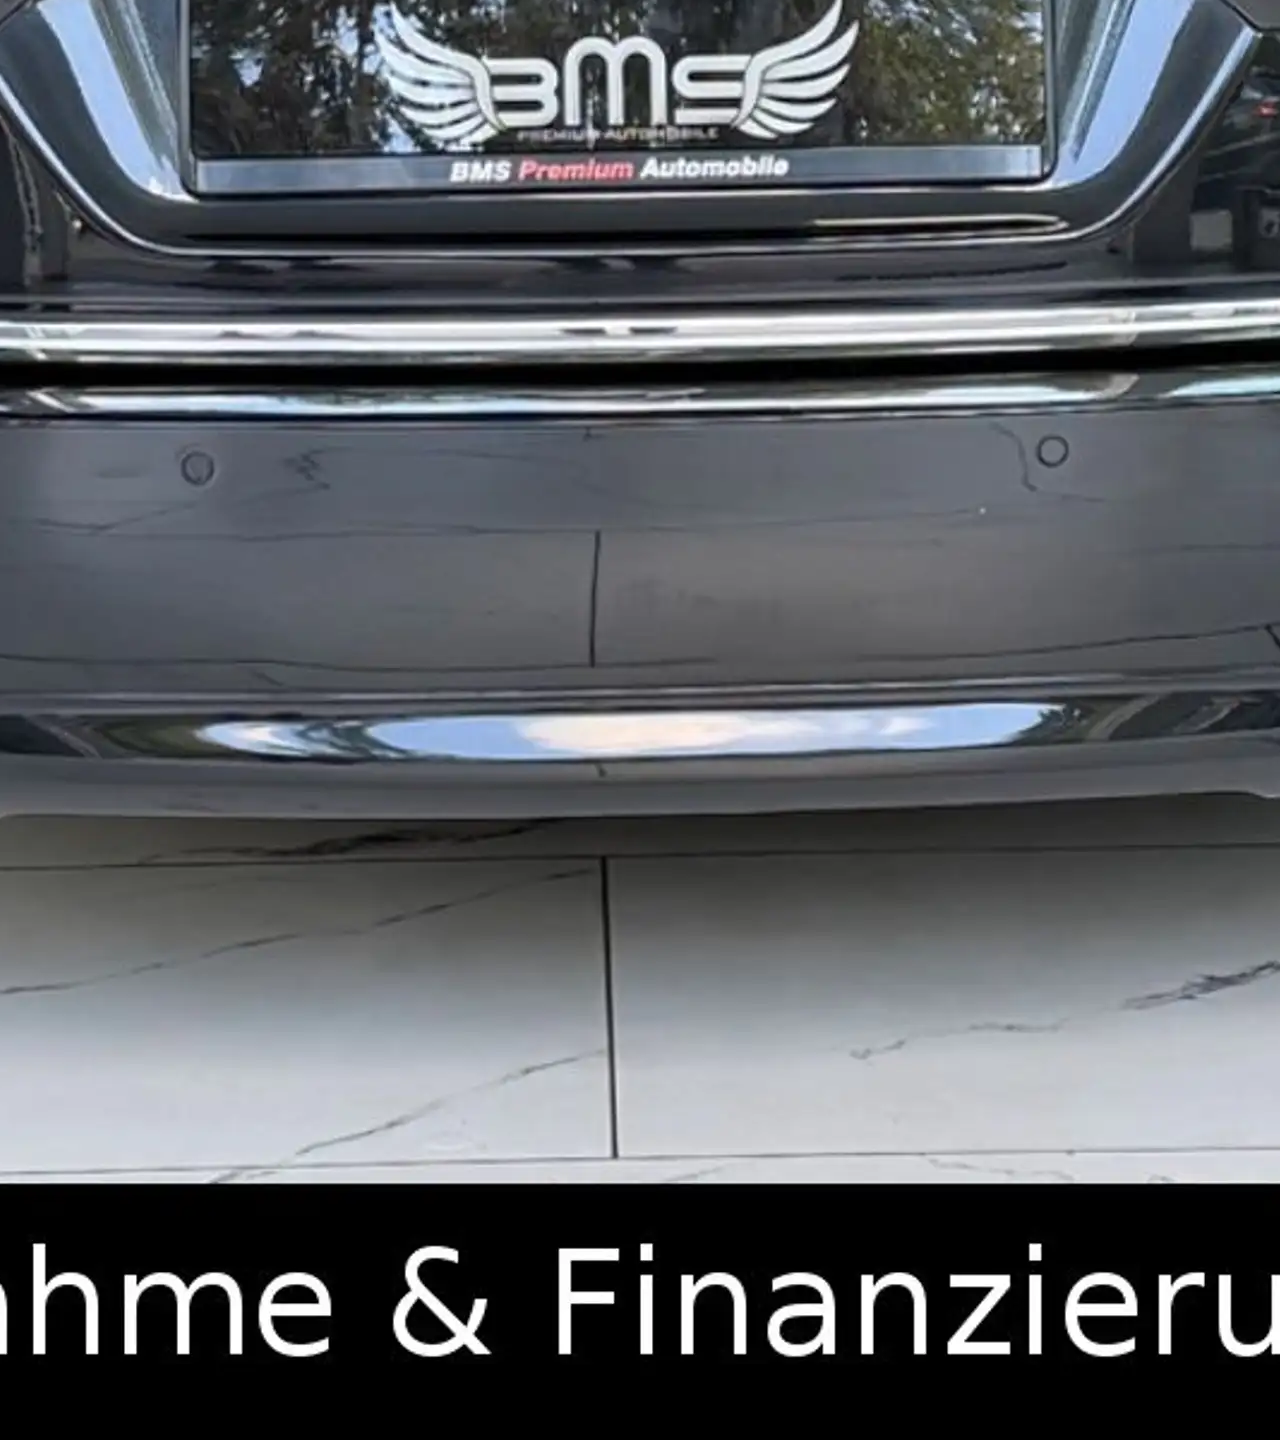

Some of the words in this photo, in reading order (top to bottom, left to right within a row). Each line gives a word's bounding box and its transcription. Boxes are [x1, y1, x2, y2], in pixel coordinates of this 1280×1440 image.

[485, 37, 756, 126] BMS
[449, 162, 511, 183] BMS
[518, 160, 635, 181] Premium
[639, 154, 790, 179] Automobile
